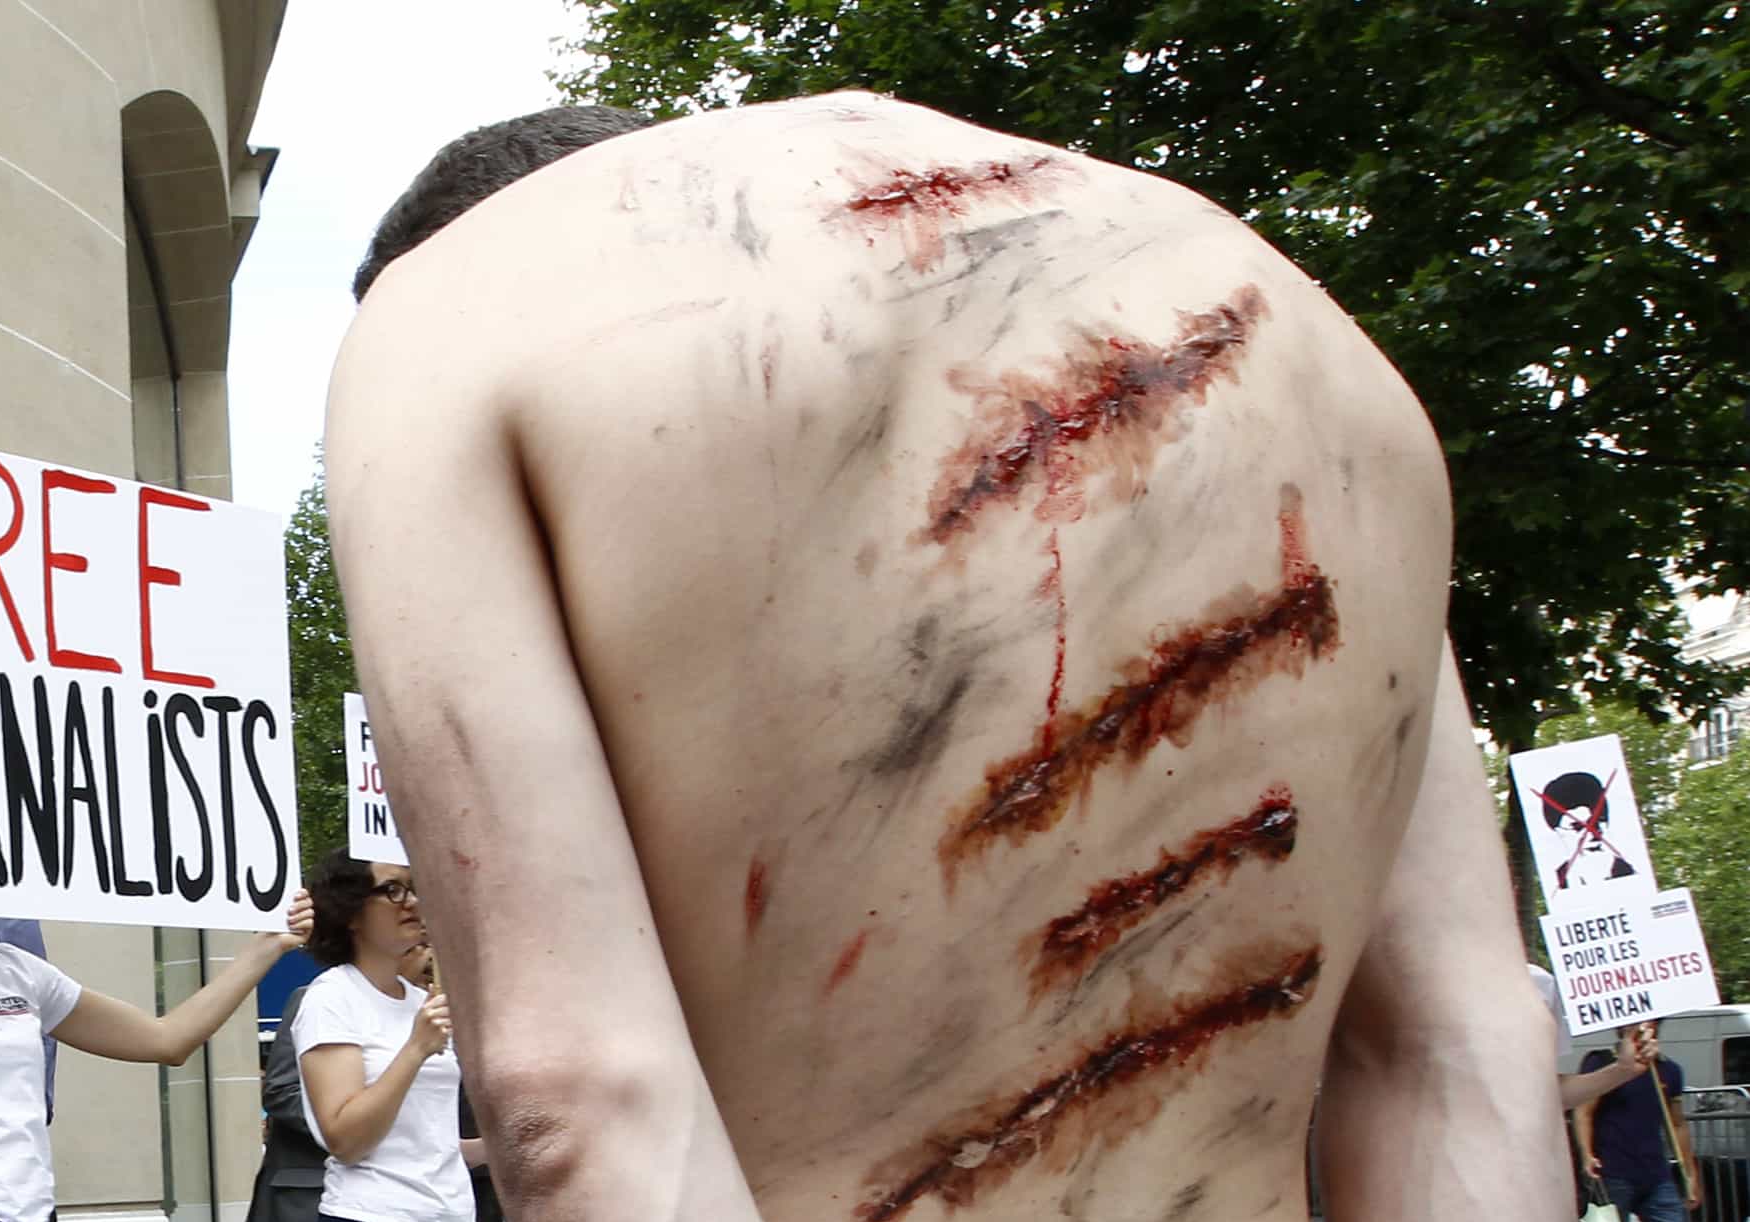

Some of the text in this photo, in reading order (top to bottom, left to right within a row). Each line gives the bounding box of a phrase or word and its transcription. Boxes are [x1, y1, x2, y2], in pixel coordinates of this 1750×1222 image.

[363, 802, 388, 836] IN
[1555, 908, 1631, 947] LIBERTÉ
[1562, 940, 1640, 972] POUR LES
[1569, 952, 1703, 1000] JOURNALISTES
[1577, 990, 1653, 1026] EN IRAN
